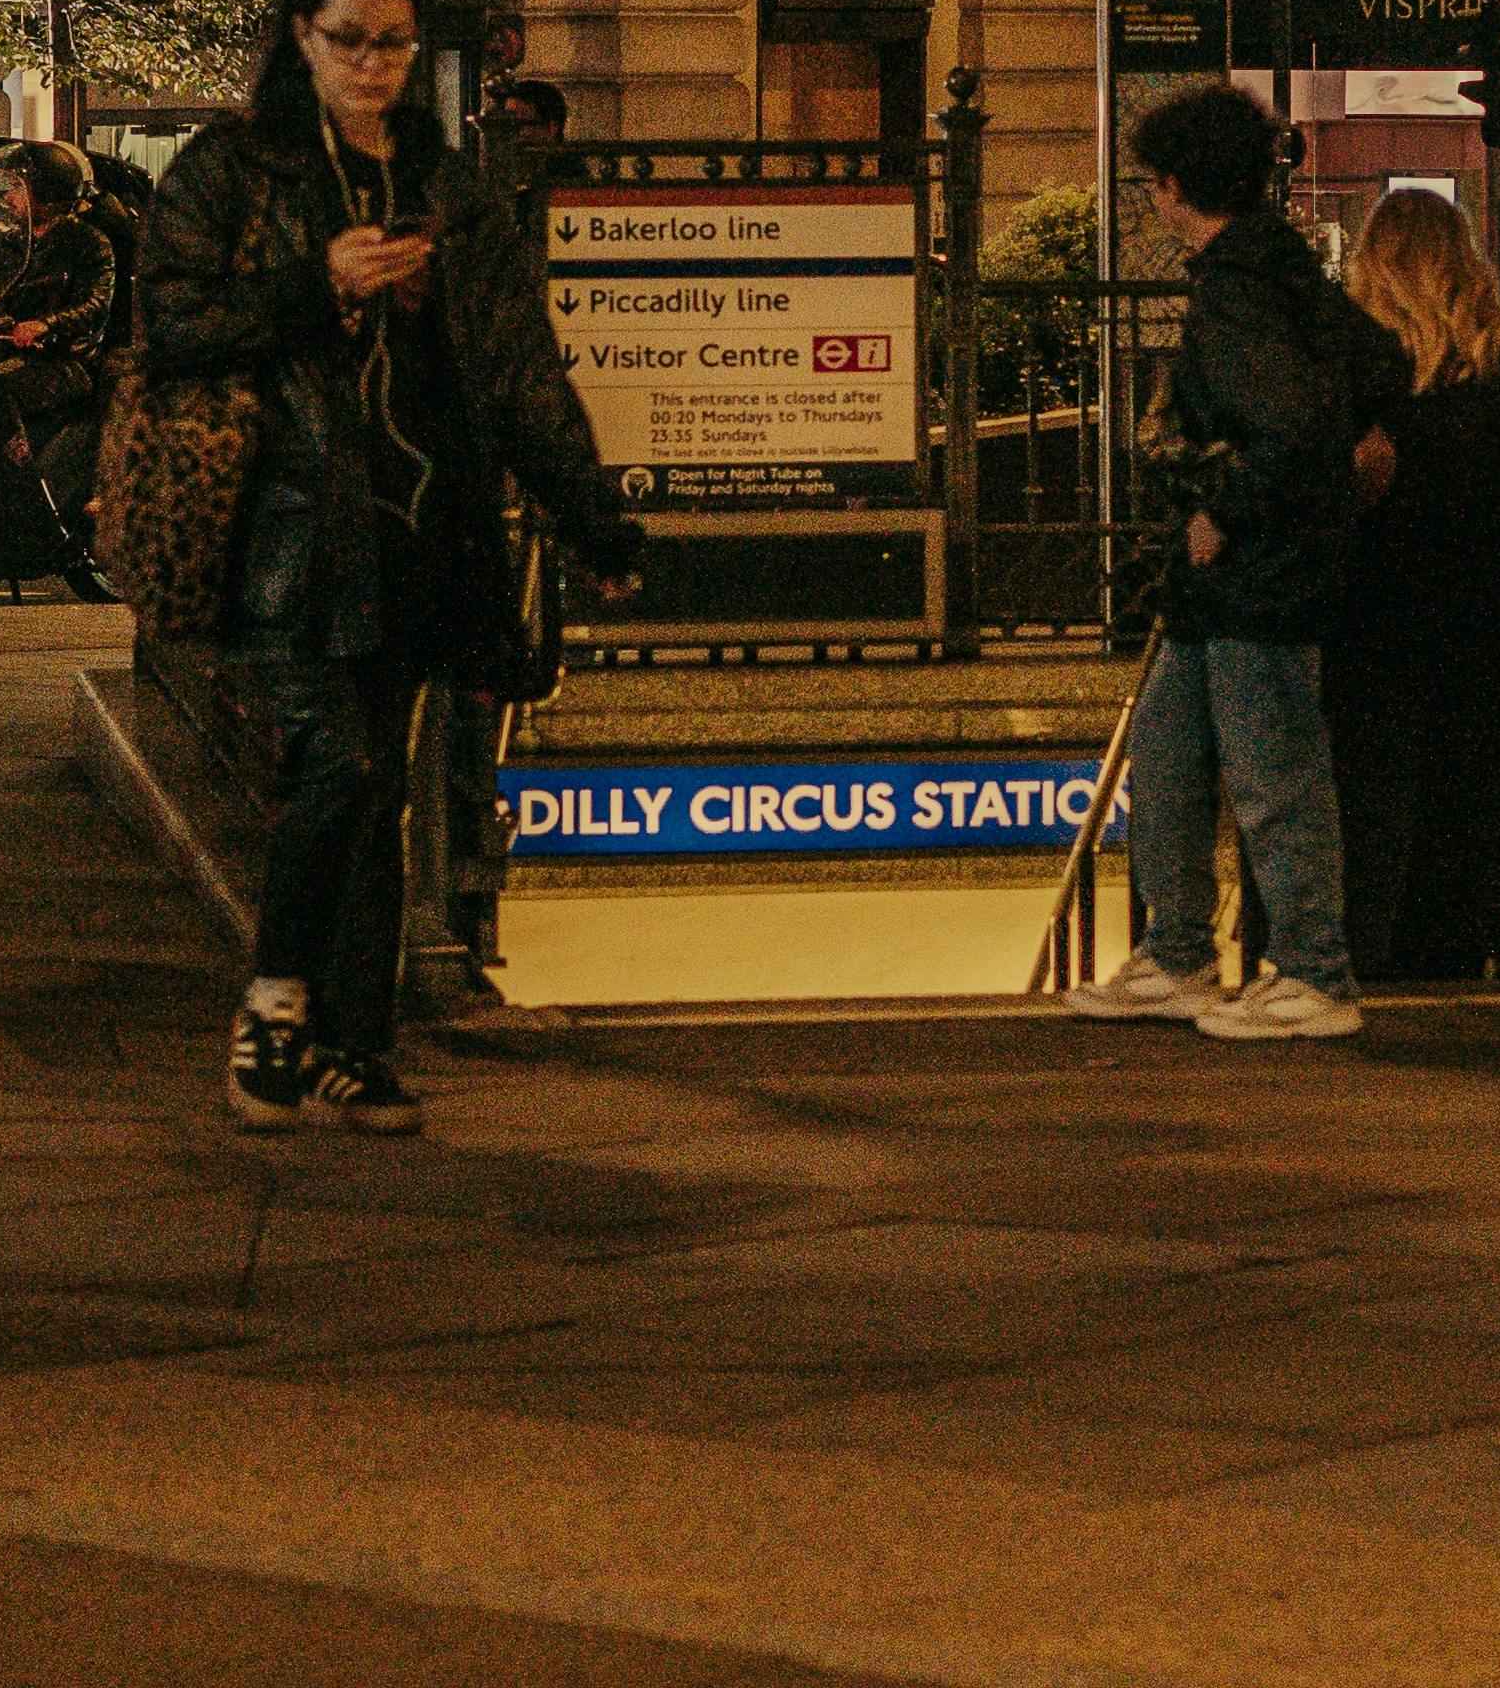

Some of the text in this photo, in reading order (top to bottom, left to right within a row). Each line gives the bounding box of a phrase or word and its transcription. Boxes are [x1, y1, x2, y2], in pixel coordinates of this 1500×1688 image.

[589, 216, 781, 241] Bakerloo line
[589, 288, 791, 318] Piccadilly line
[589, 343, 800, 369] Visitor Centre
[651, 391, 882, 406] This entrance is closed after
[701, 410, 773, 426] Mondays
[779, 411, 797, 423] to
[803, 409, 883, 424] Thursdays
[701, 428, 766, 444] Sundays
[667, 468, 705, 482] Open
[730, 468, 766, 482] Night
[770, 466, 801, 480] Tube
[804, 468, 823, 479] on
[667, 483, 706, 496] Friday
[710, 483, 733, 495] and
[736, 482, 792, 496] Saturday
[519, 788, 672, 837] DILLY
[690, 783, 897, 834] CIRCUS
